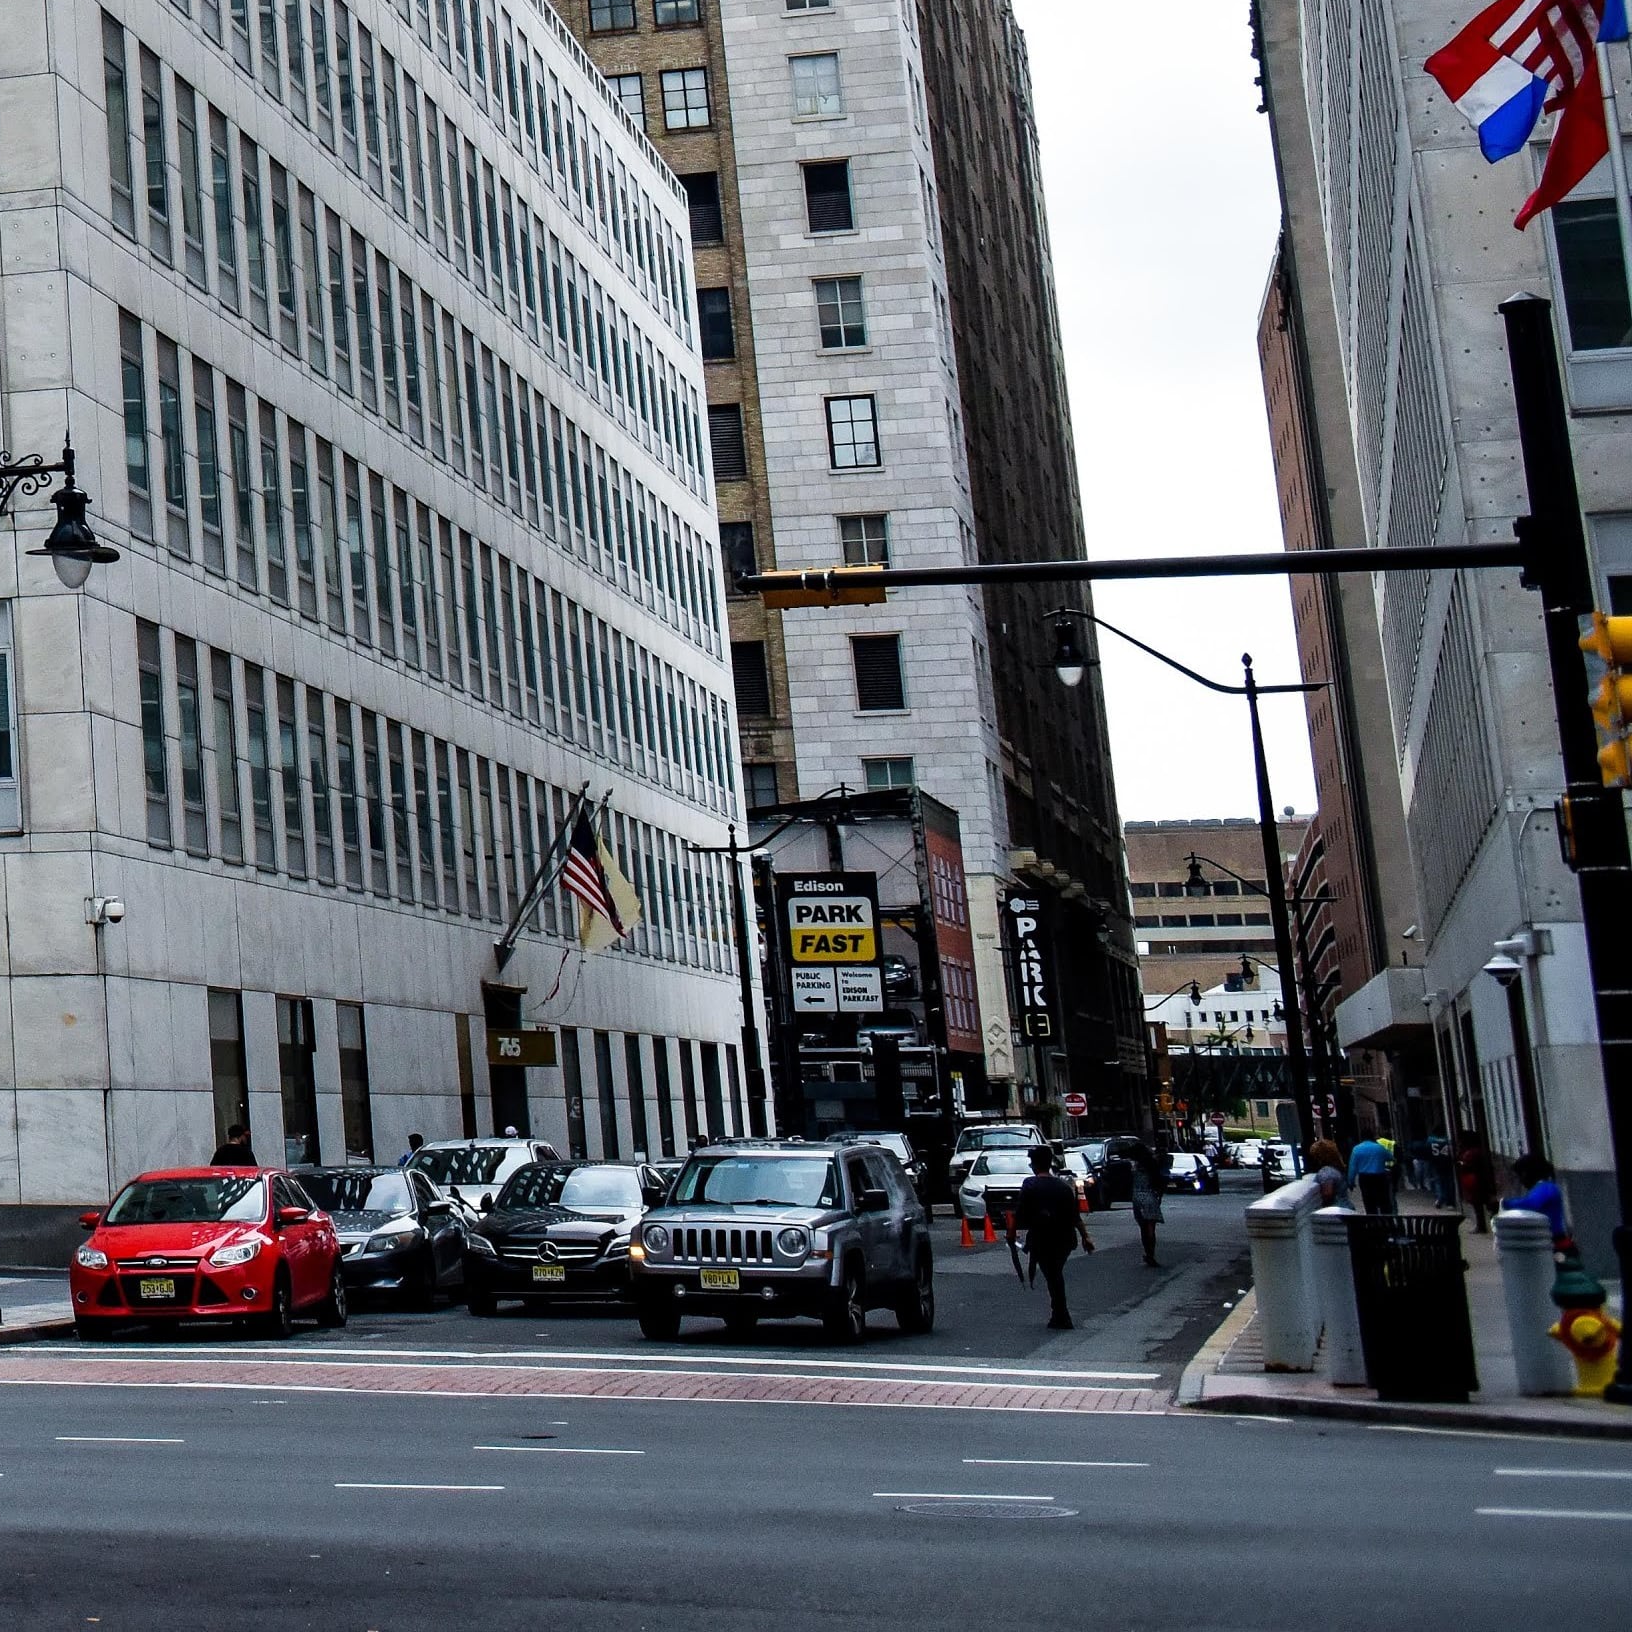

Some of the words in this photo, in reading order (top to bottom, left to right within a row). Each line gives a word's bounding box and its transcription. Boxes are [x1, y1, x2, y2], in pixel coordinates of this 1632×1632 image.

[793, 880, 844, 892] Edison
[795, 905, 864, 923] PARK
[800, 934, 864, 953] FAST
[1016, 917, 1047, 1006] PARK
[796, 972, 821, 980] PUBLIC
[498, 1037, 521, 1057] 765
[1431, 1143, 1449, 1157] 54
